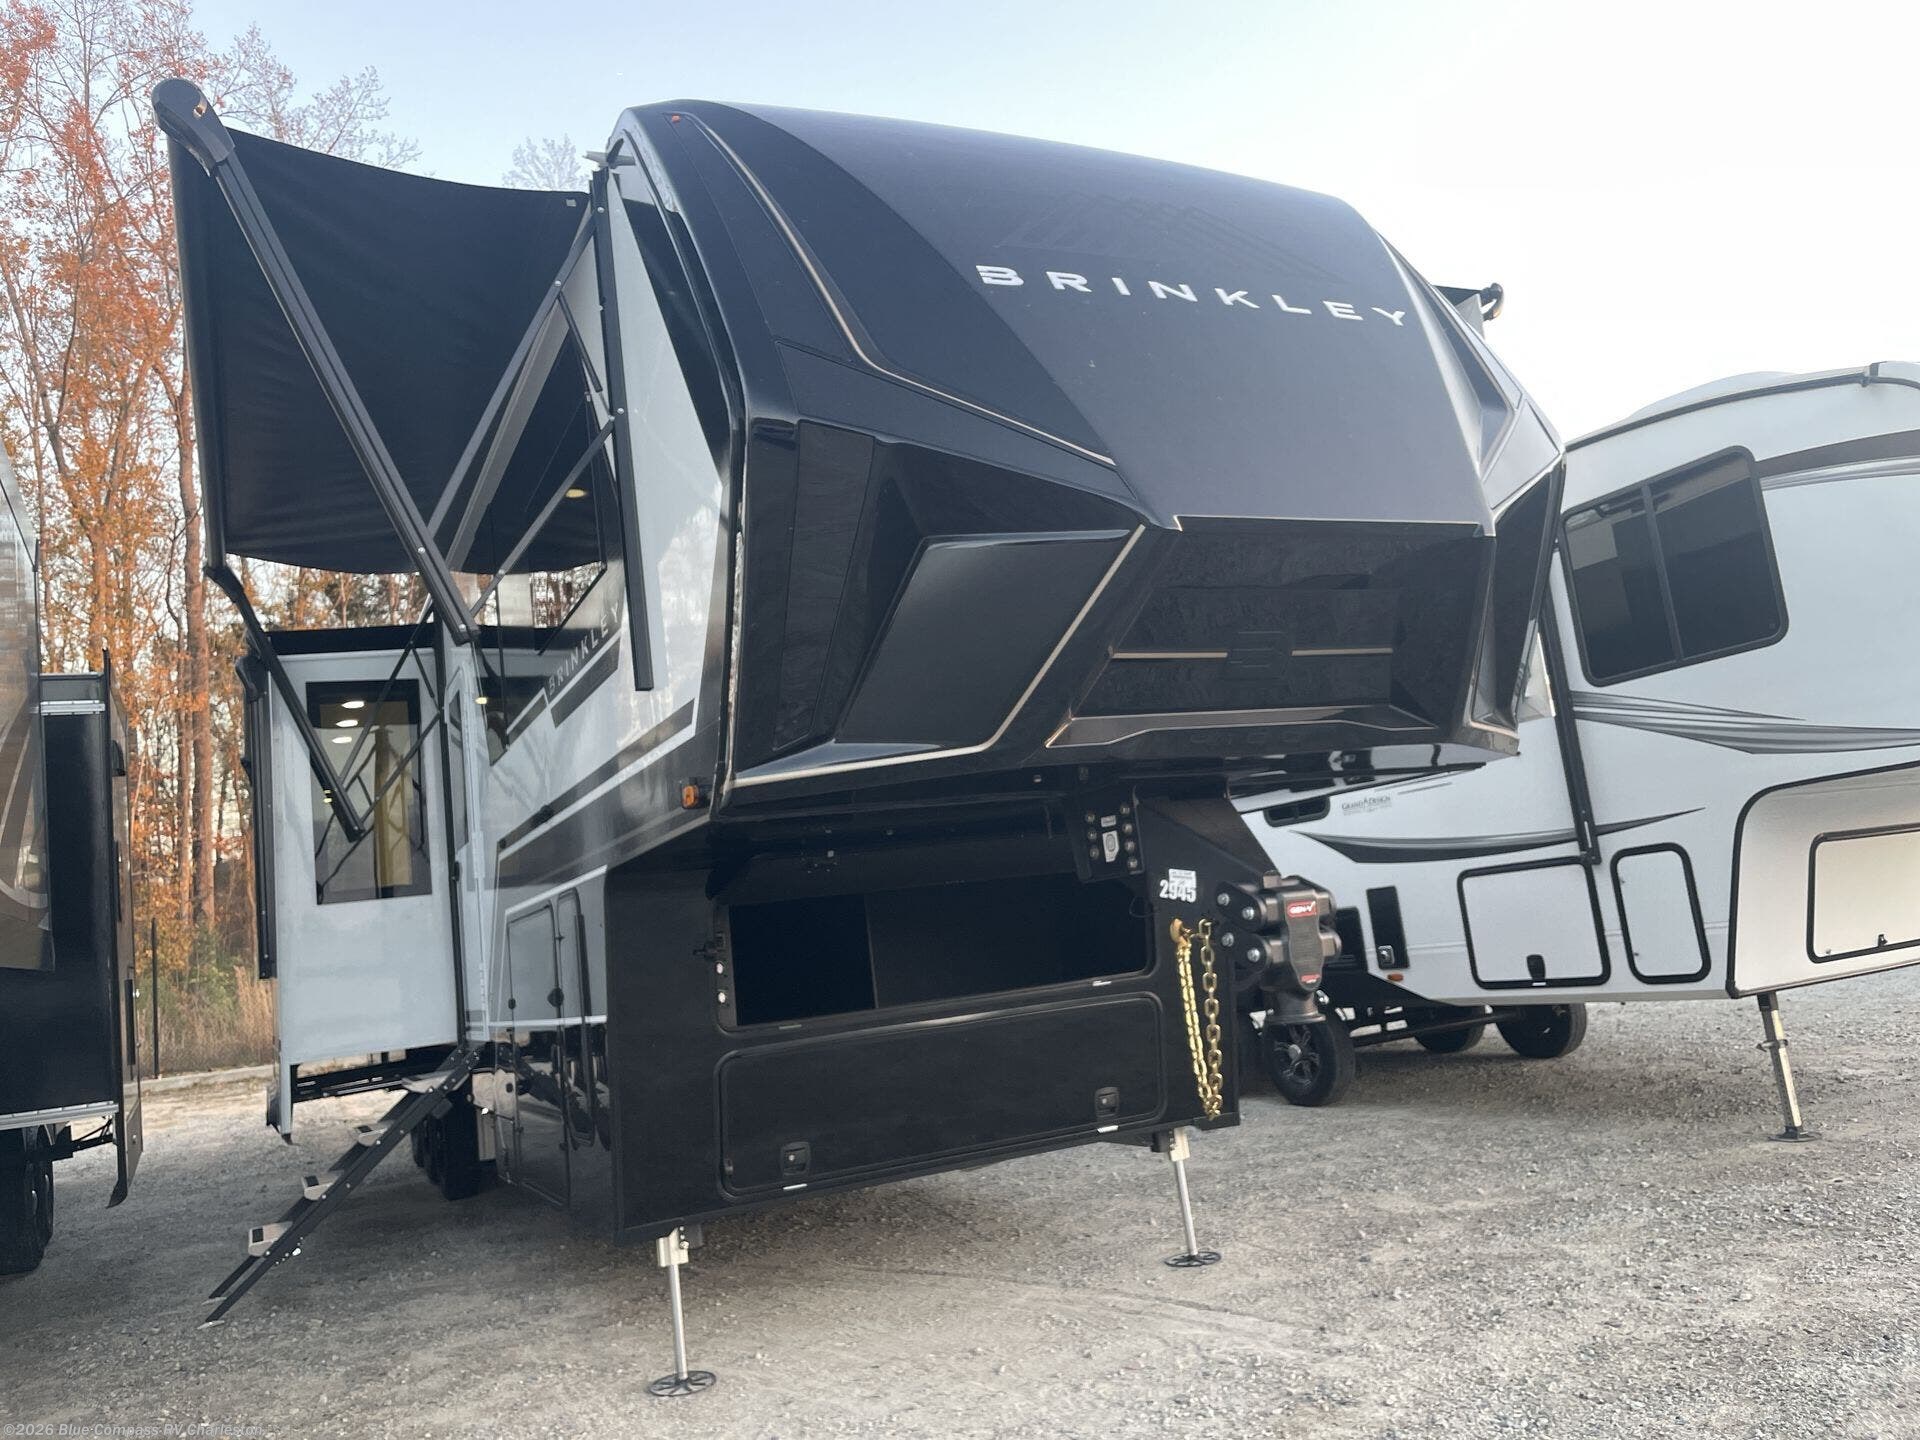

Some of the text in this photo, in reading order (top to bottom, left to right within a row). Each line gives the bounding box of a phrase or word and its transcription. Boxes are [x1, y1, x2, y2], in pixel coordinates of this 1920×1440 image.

[975, 264, 1407, 327] BRINKLEY
[547, 602, 619, 697] BRINKLEY
[1159, 879, 1196, 903] 2945
